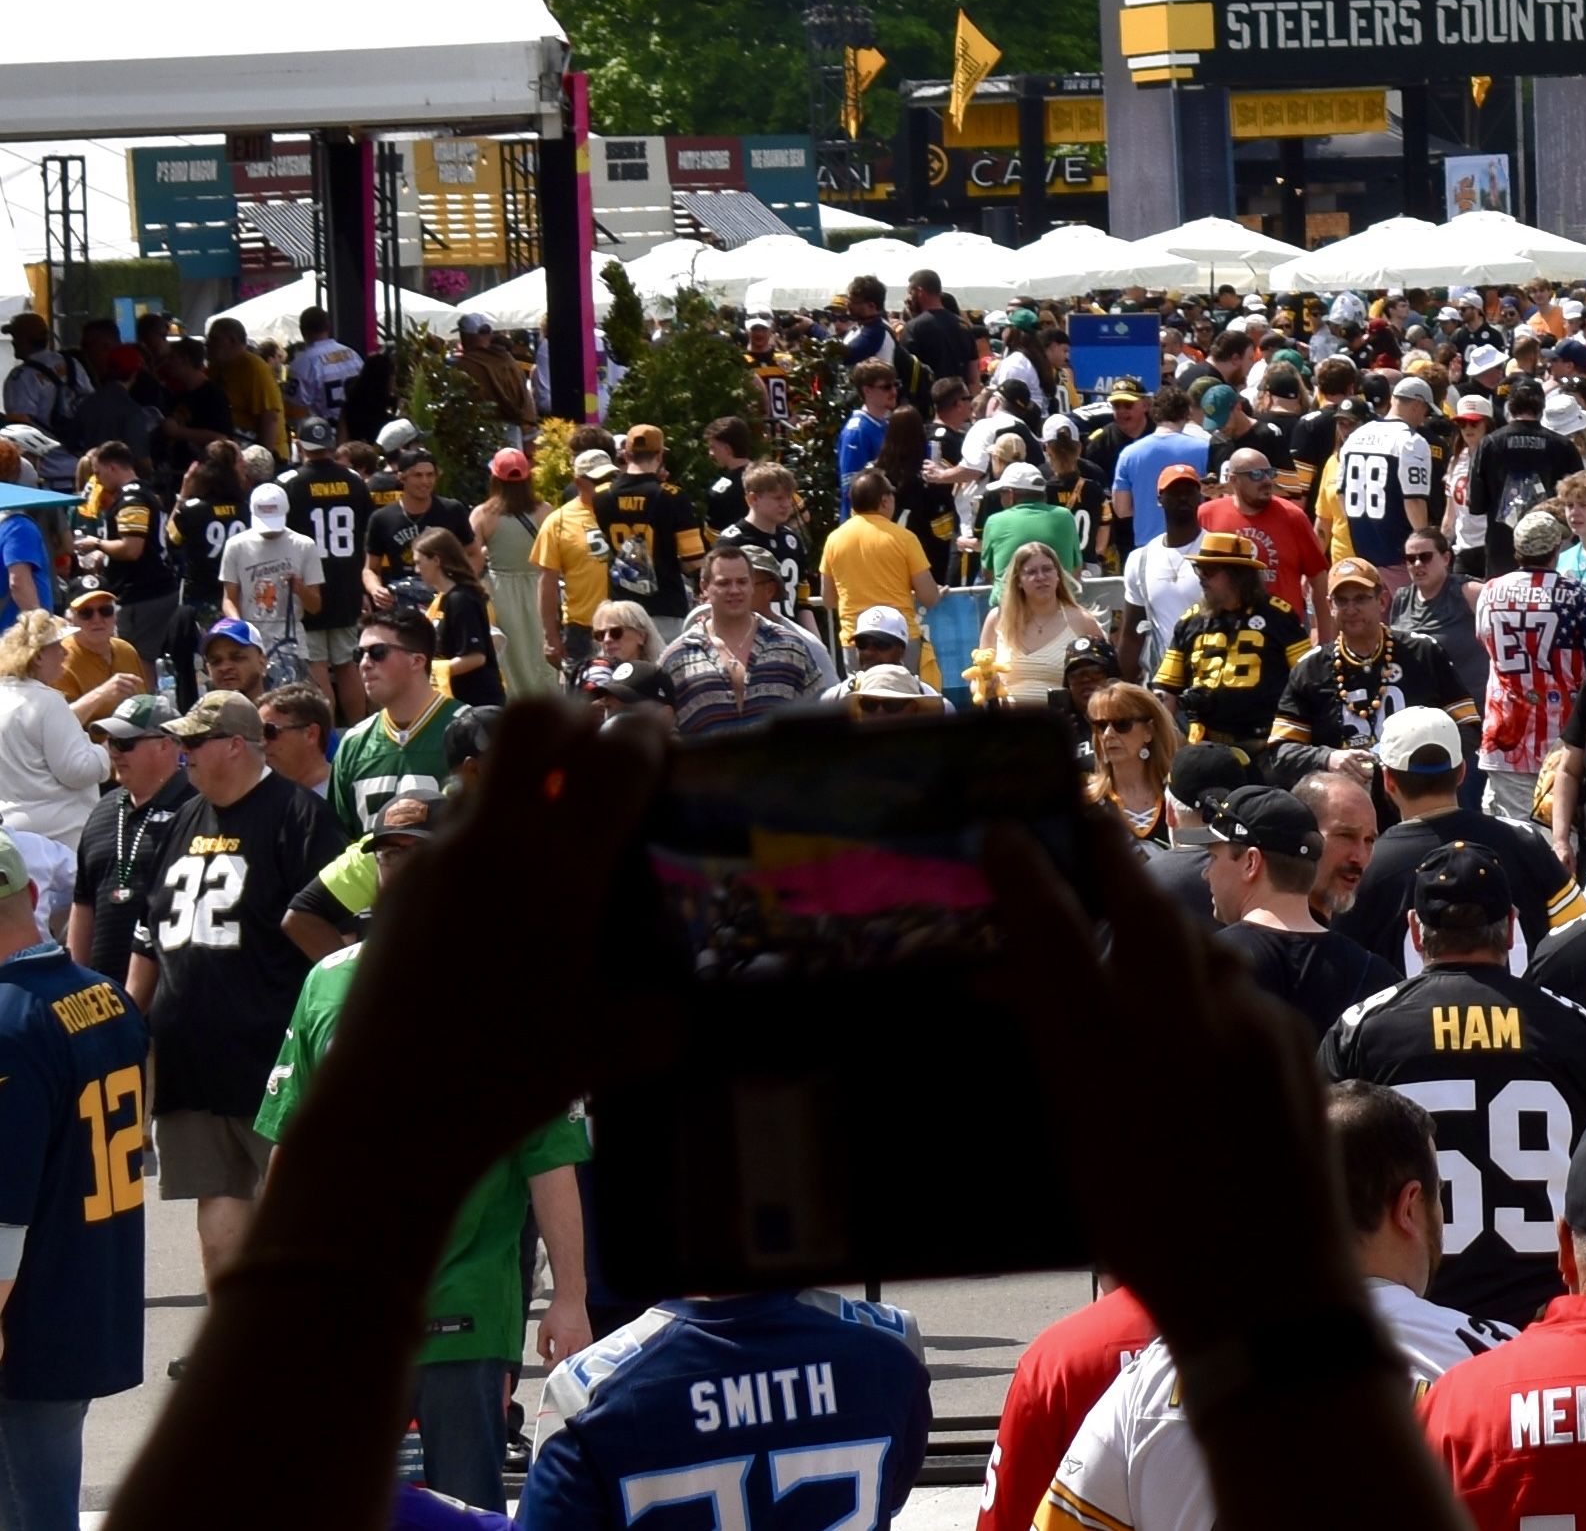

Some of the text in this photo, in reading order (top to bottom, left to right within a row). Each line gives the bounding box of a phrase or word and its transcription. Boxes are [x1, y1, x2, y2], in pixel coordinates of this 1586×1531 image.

[1507, 436, 1546, 450] WOODSON
[310, 481, 349, 497] HOWARD
[619, 496, 645, 511] WATT
[1344, 454, 1388, 518] 88
[1408, 466, 1429, 485] 88
[311, 506, 354, 558] 18
[1490, 609, 1560, 674] E7
[158, 854, 248, 952] 32
[1432, 1006, 1521, 1050] HAM
[78, 1064, 145, 1223] 12
[1391, 1079, 1573, 1255] 59
[690, 1361, 837, 1433] SMITH
